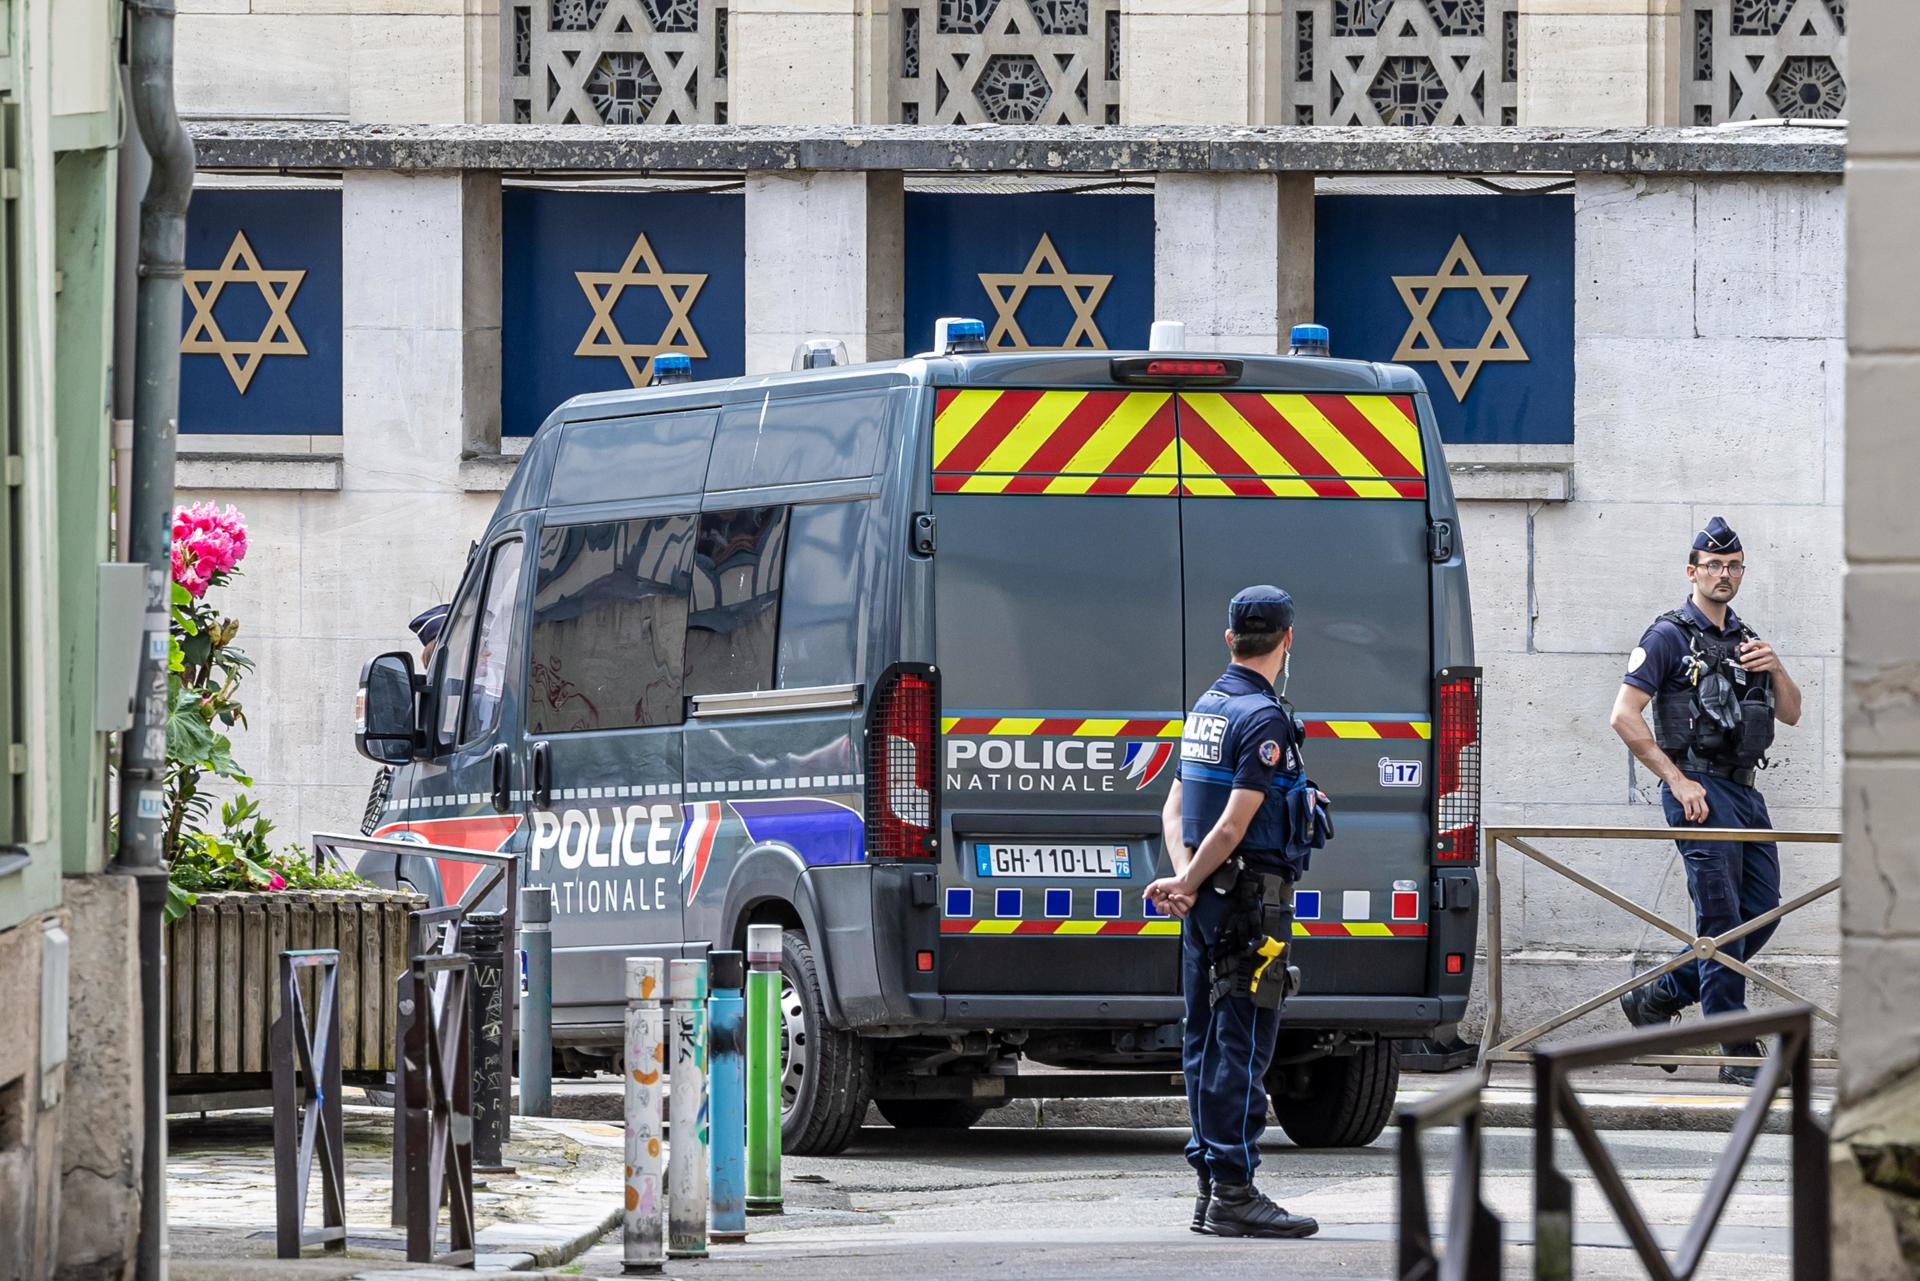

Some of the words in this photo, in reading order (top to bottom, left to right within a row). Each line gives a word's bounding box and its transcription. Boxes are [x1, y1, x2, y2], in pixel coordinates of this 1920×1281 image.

[947, 740, 1115, 770] POLICE
[946, 773, 1115, 792] NATIONALE
[1395, 764, 1418, 782] 17
[531, 804, 674, 871] POLICE
[996, 848, 1112, 873] GH-110-LL
[1116, 862, 1130, 874] 76
[531, 877, 666, 915] ATIONALE
